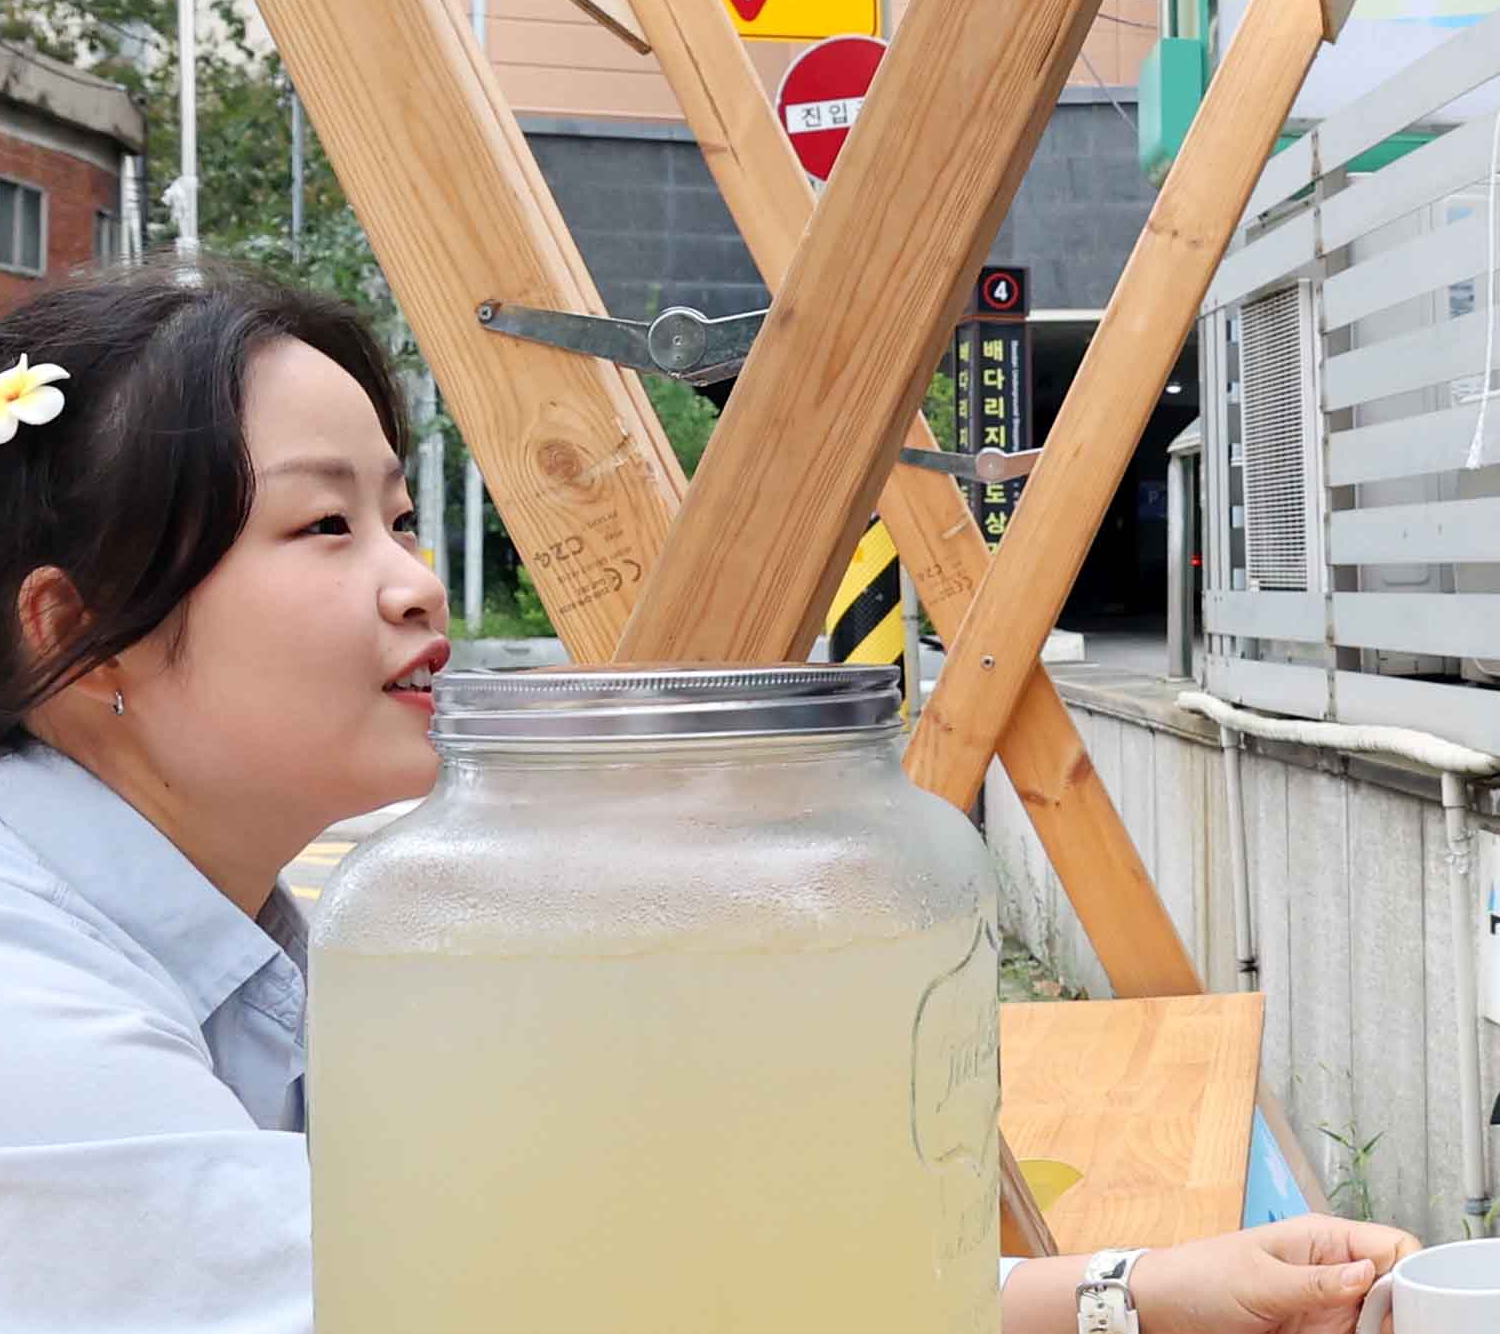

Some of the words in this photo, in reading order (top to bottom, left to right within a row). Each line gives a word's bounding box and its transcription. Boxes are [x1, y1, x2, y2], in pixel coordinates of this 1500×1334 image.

[802, 101, 864, 128] 진입
[993, 280, 1009, 302] 4
[983, 339, 1008, 555] 배다리지도상
